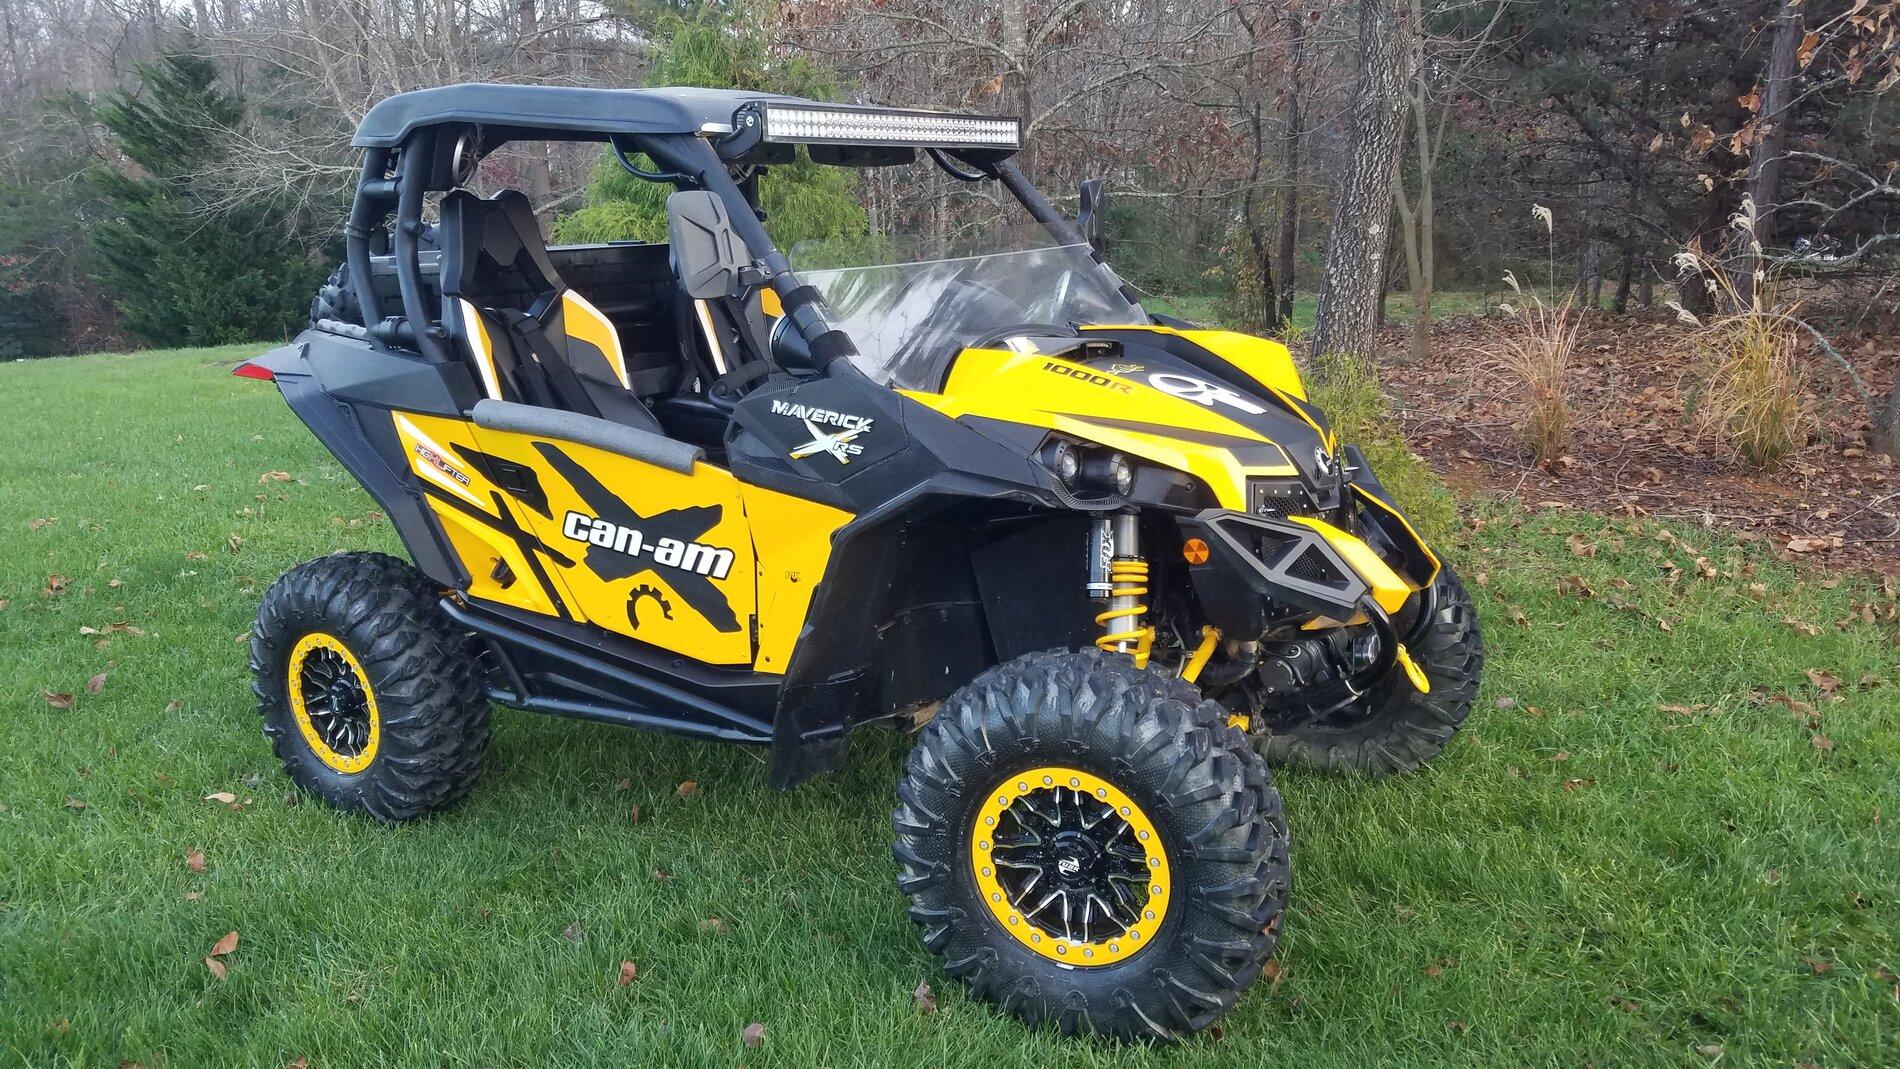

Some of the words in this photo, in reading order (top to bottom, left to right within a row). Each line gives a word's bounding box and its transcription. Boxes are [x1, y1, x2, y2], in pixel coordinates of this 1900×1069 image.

[1042, 361, 1134, 395] 1000R
[770, 399, 875, 433] MAVERICK
[562, 510, 735, 581] can-am
